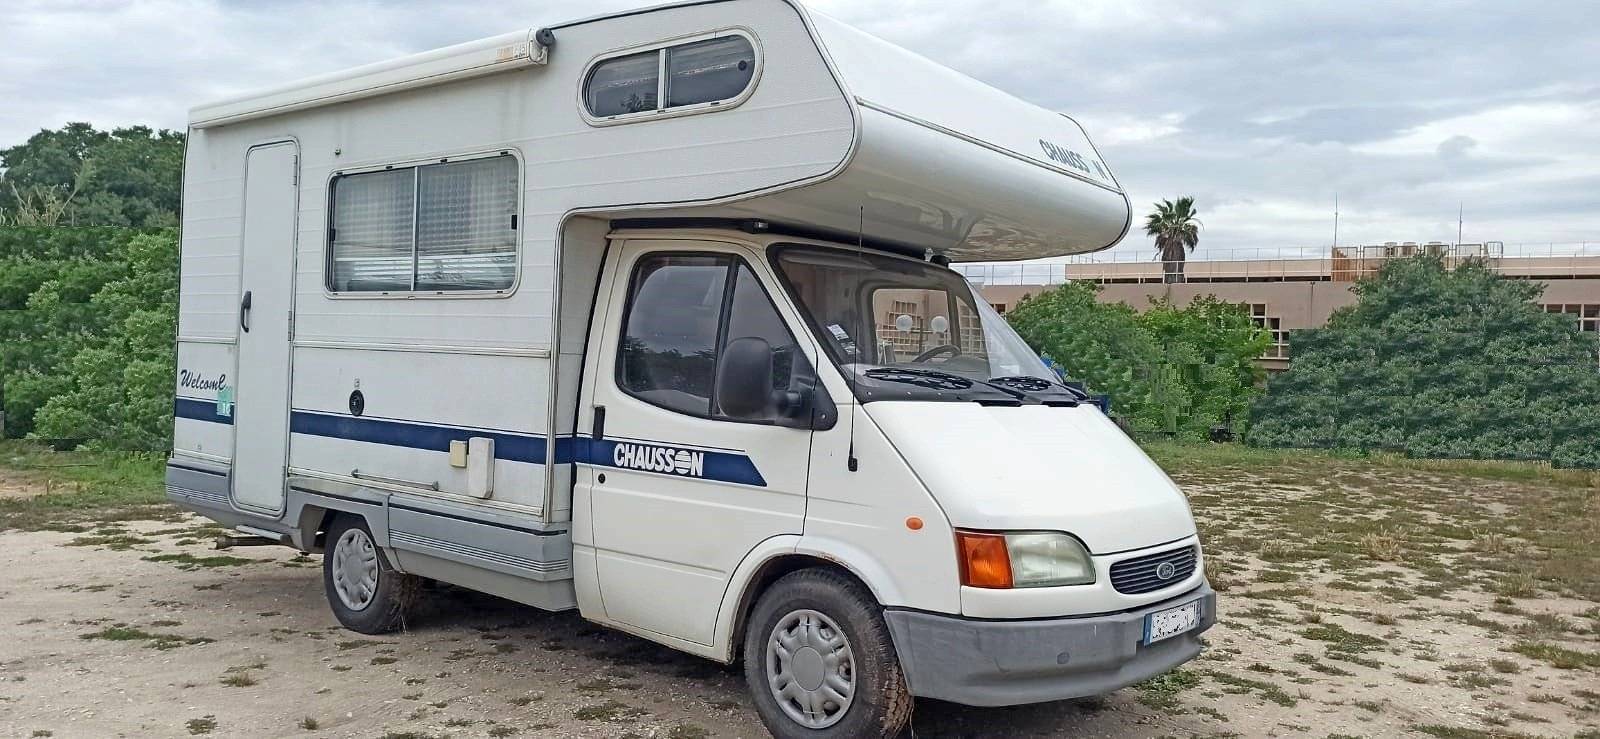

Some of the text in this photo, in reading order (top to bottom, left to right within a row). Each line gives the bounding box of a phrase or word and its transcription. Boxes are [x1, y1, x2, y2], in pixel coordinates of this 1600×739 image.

[1039, 139, 1109, 180] CHAUSSN
[180, 369, 226, 390] Welcome
[613, 443, 704, 477] CHAUSSON
